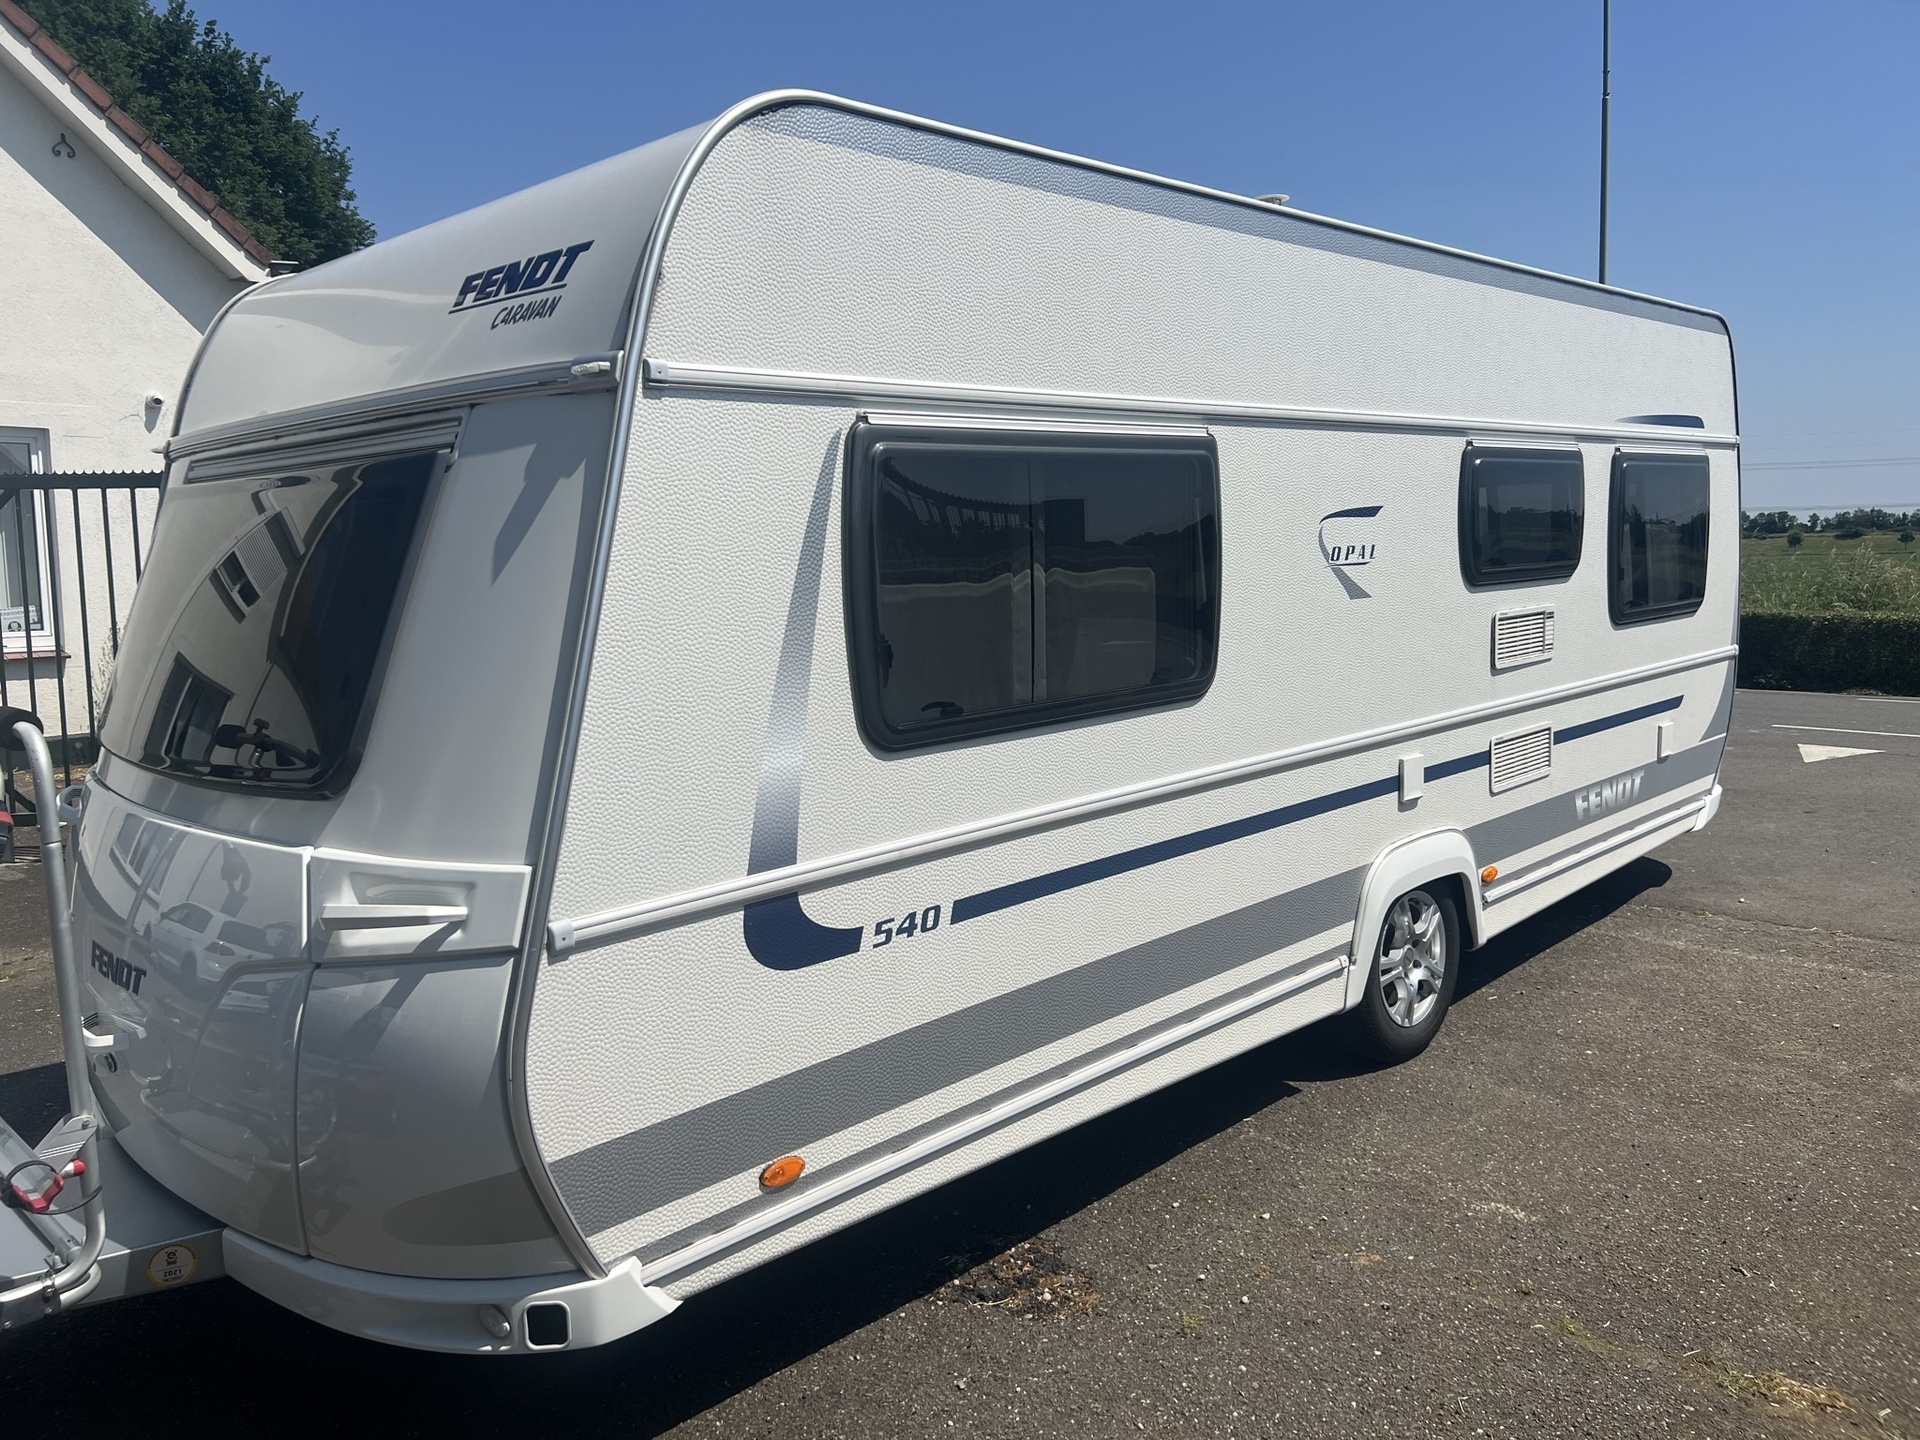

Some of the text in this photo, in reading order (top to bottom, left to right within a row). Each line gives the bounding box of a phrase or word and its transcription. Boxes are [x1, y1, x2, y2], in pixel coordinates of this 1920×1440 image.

[452, 240, 595, 308] FENDT
[490, 295, 562, 330] CARAVAN
[1330, 544, 1376, 561] OPAL
[1575, 769, 1645, 820] FENDT
[873, 904, 941, 949] 540
[91, 940, 147, 996] FENDT
[163, 1268, 183, 1278] 2021
